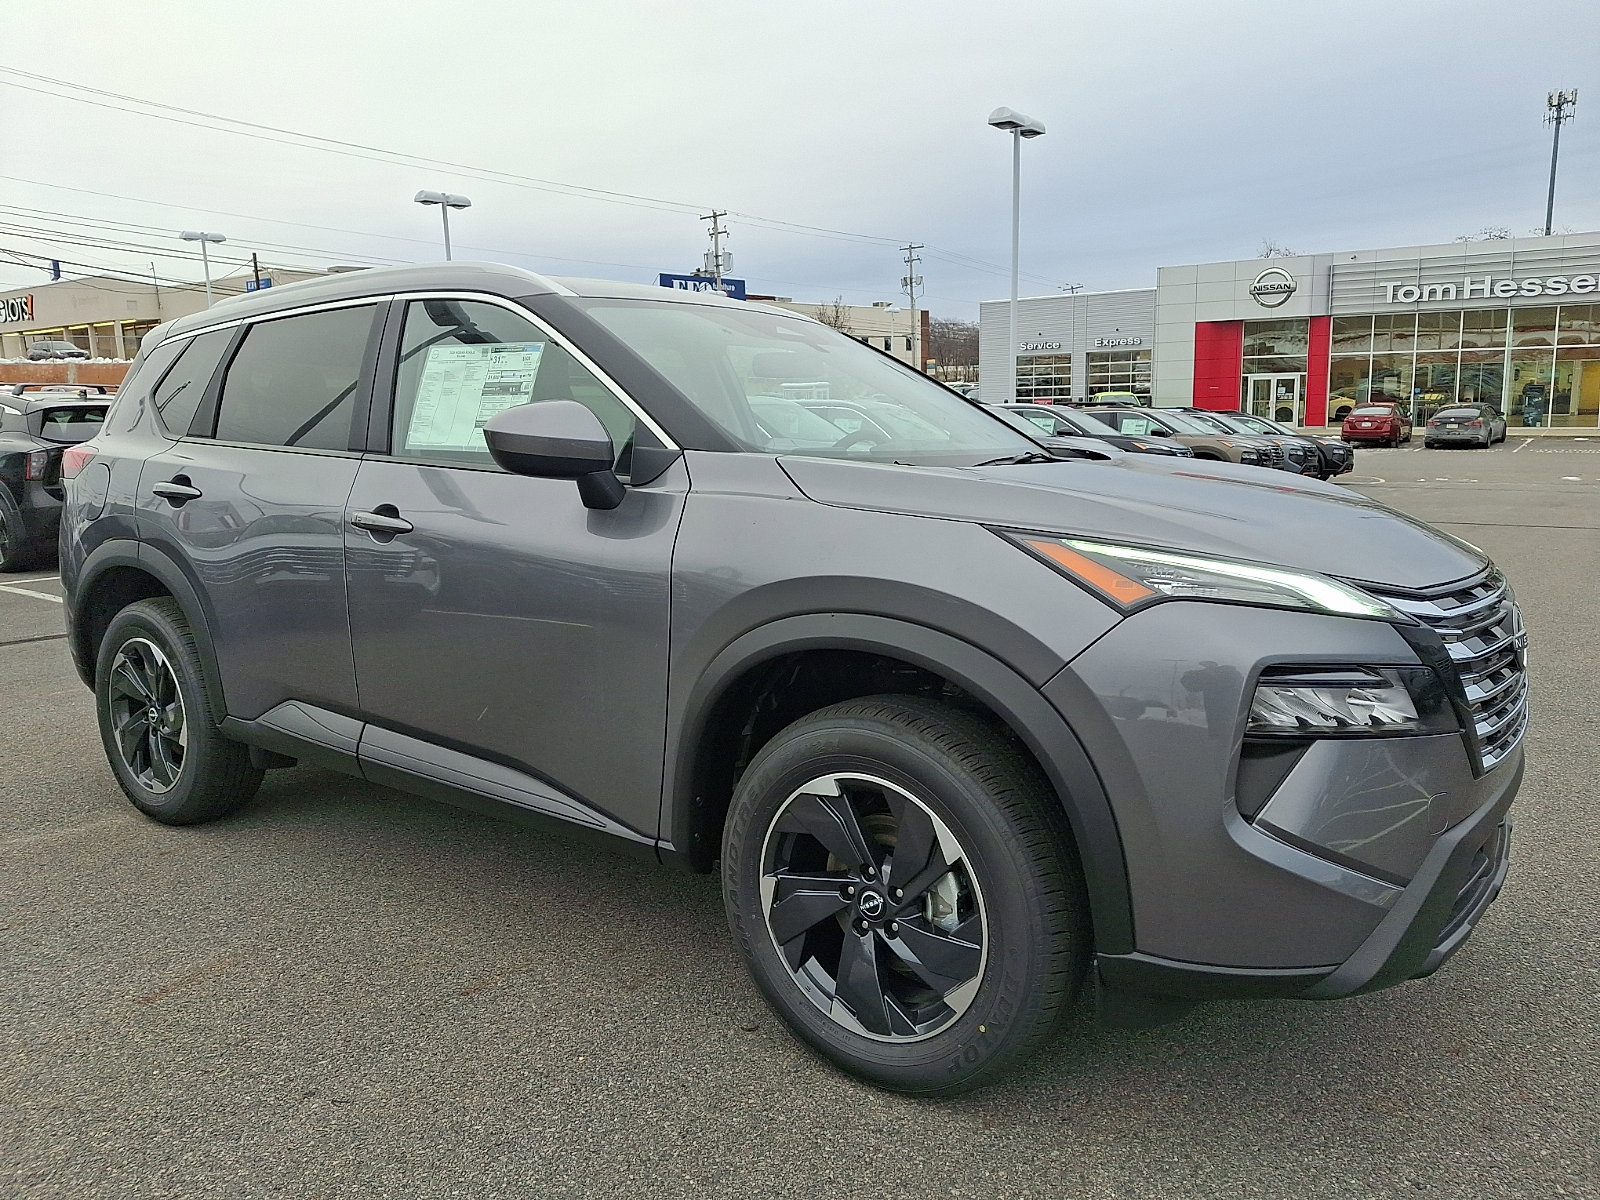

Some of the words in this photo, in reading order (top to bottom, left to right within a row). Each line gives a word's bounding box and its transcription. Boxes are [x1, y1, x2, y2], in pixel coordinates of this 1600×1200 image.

[1380, 281, 1457, 303] Tom
[1464, 274, 1600, 299] Hesse
[1019, 341, 1060, 351] Service
[1094, 337, 1141, 347] Express
